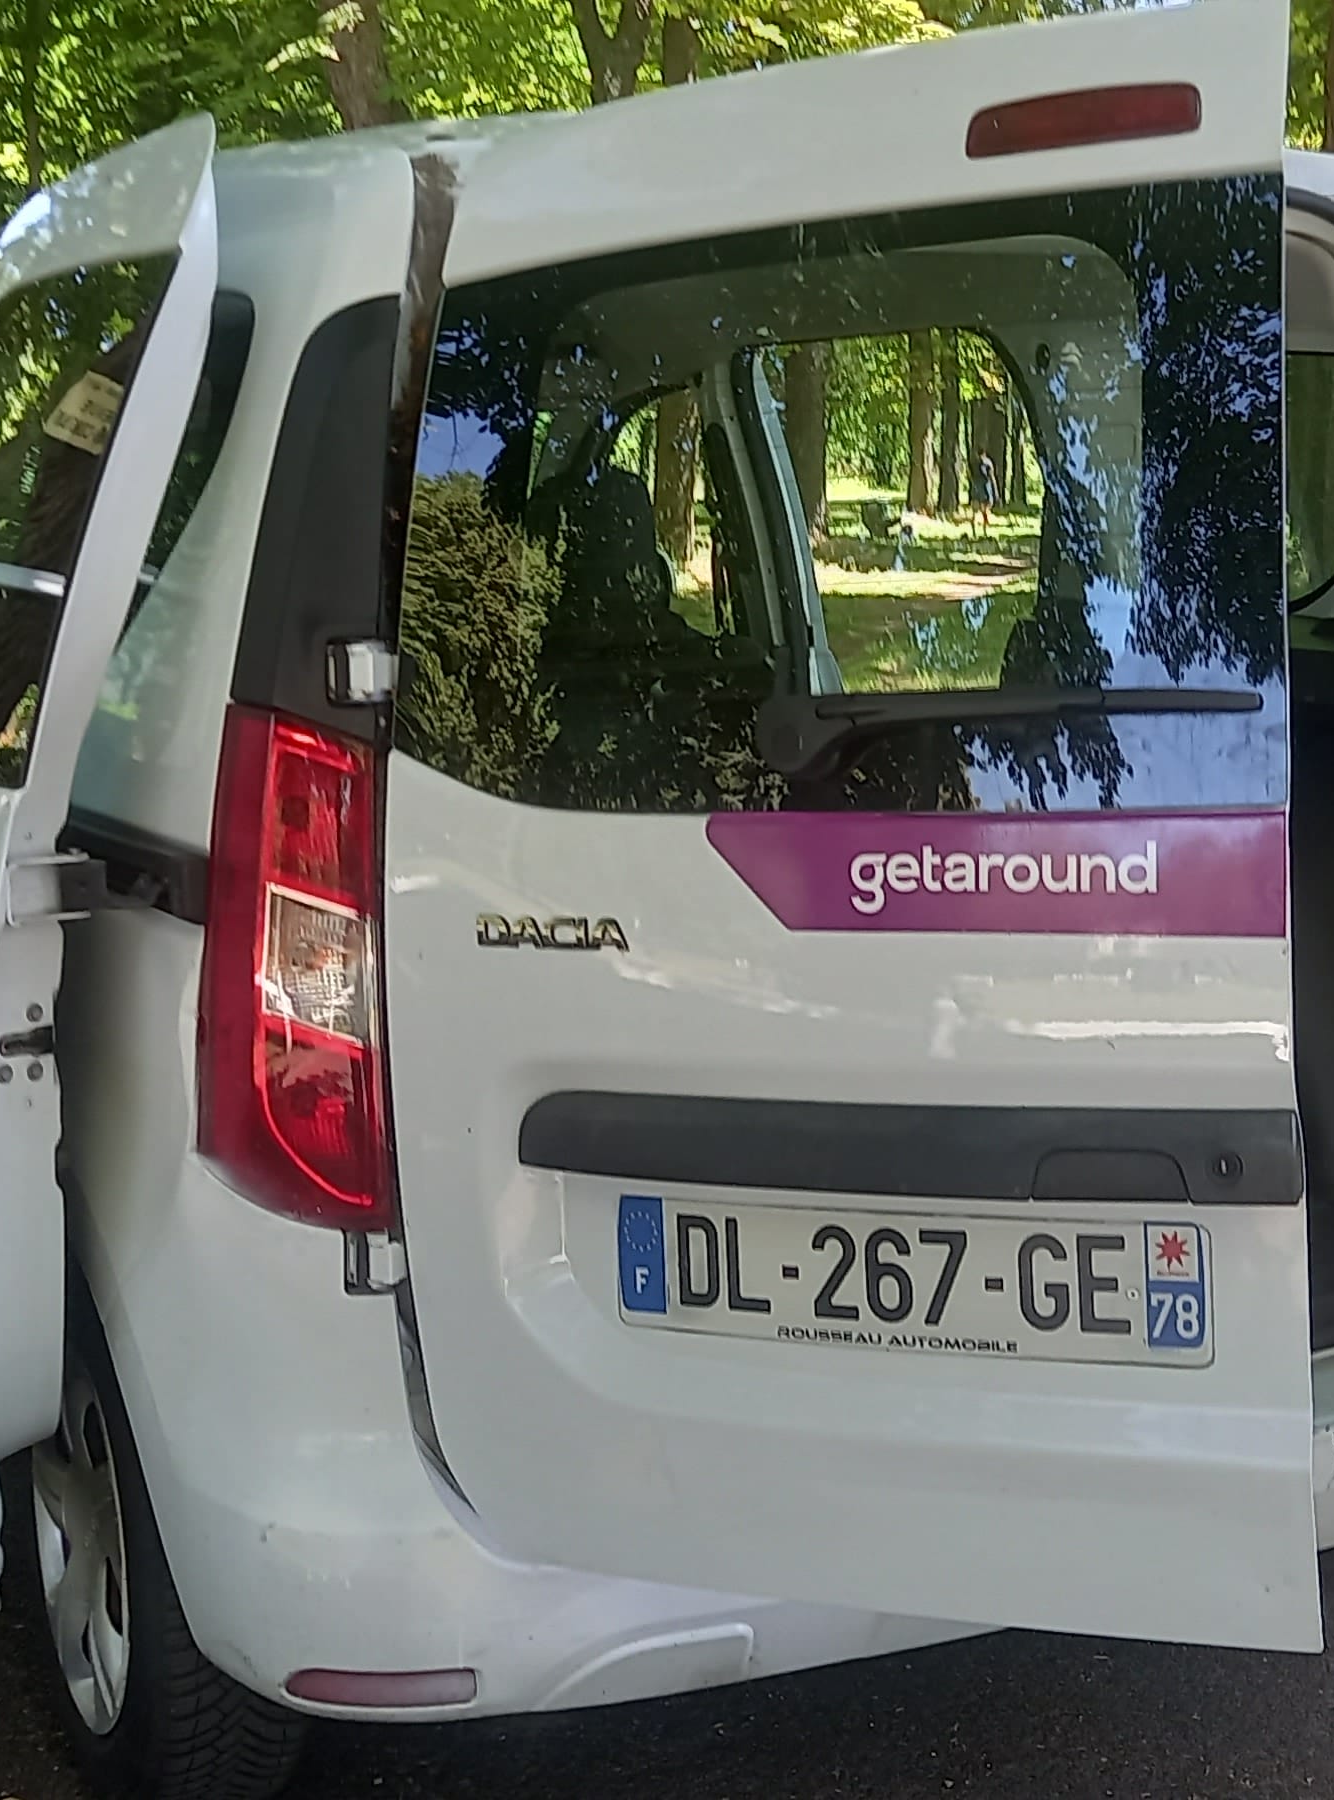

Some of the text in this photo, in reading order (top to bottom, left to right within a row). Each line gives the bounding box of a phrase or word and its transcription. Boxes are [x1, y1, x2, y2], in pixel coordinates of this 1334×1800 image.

[849, 840, 1158, 915] getaround
[475, 913, 630, 953] DACIA
[633, 1266, 650, 1296] F
[676, 1213, 1132, 1336] DL-267-GE
[1150, 1291, 1201, 1341] 78
[777, 1325, 1019, 1354] ROUSSEAU AUTOMOBILE
